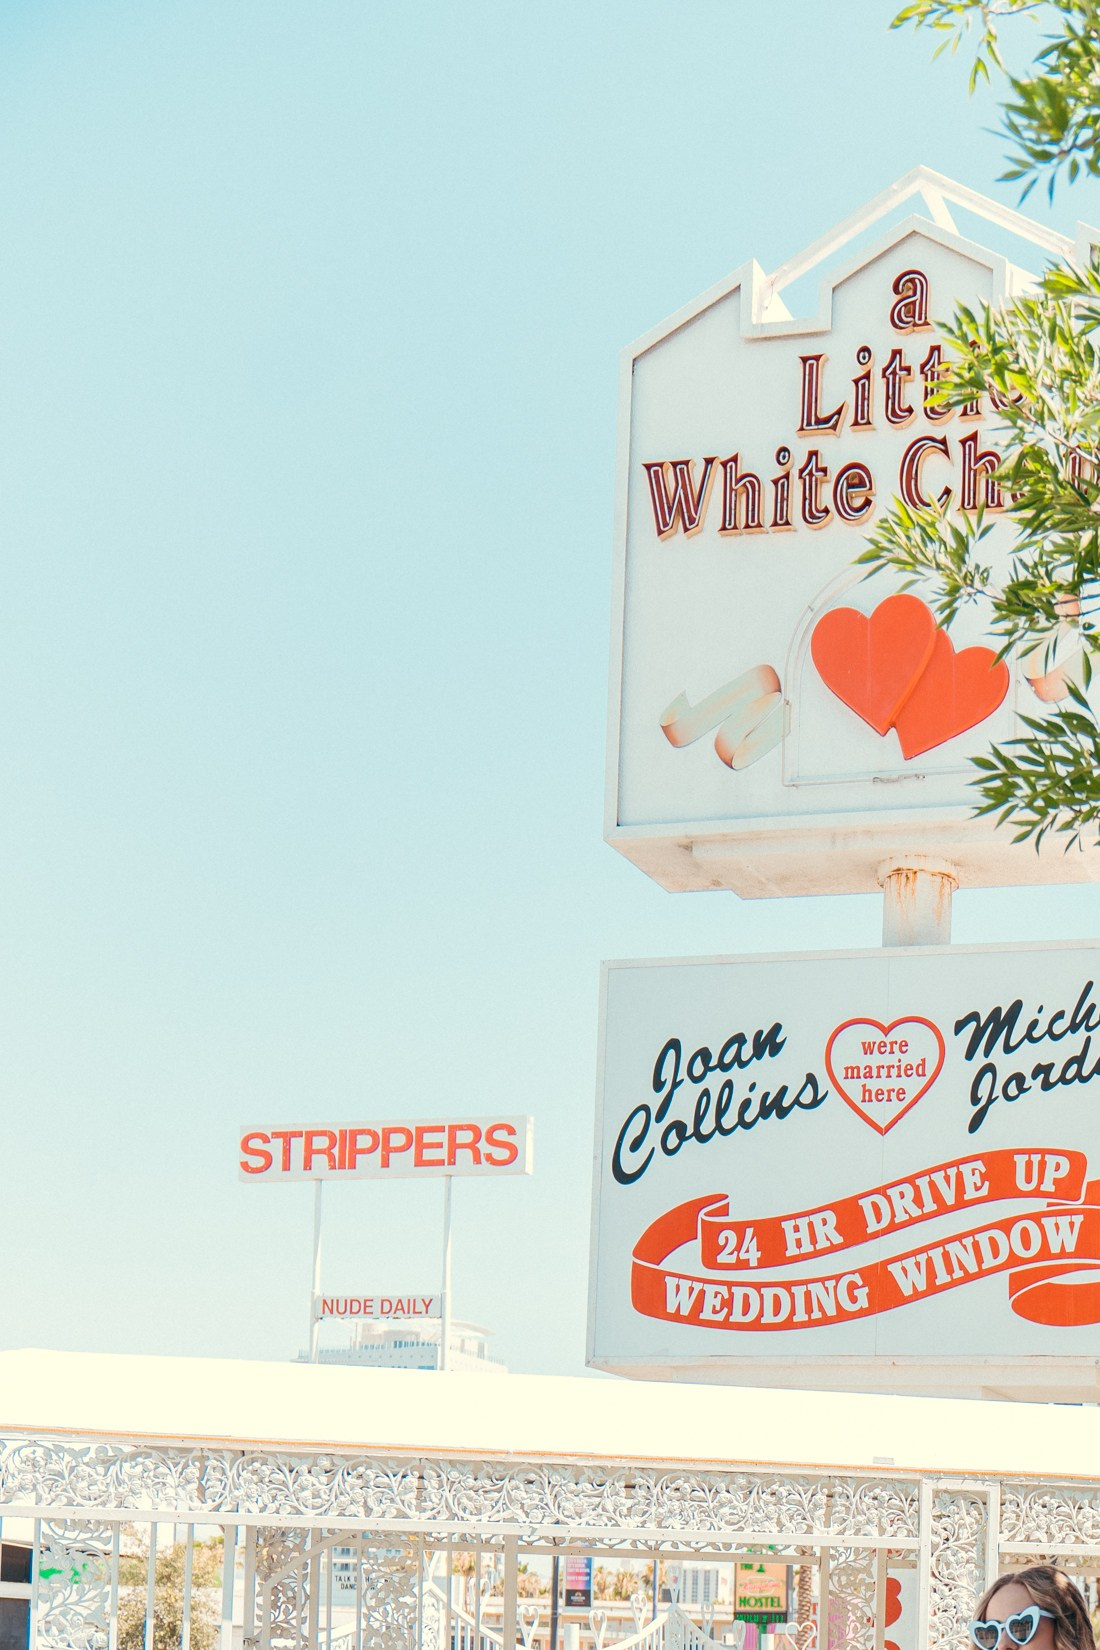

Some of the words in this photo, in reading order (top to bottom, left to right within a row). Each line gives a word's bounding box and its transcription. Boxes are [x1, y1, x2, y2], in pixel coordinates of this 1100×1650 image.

[890, 269, 933, 332] a
[642, 445, 875, 538] White
[652, 1022, 788, 1124] Joan
[843, 1057, 927, 1079] married
[861, 1039, 909, 1055] were
[860, 1083, 906, 1103] here
[239, 1122, 519, 1174] STRIPPERS
[611, 1073, 829, 1186] Collins
[717, 1228, 761, 1267] 24
[783, 1210, 844, 1257] HR
[864, 1160, 990, 1234] DRIVE
[1013, 1153, 1070, 1192] UP
[664, 1275, 869, 1324] WEDDING
[887, 1214, 1084, 1297] WINDOW
[321, 1298, 374, 1316] NUDE
[379, 1298, 433, 1315] DAILY
[738, 1596, 783, 1608] HOSTEL
